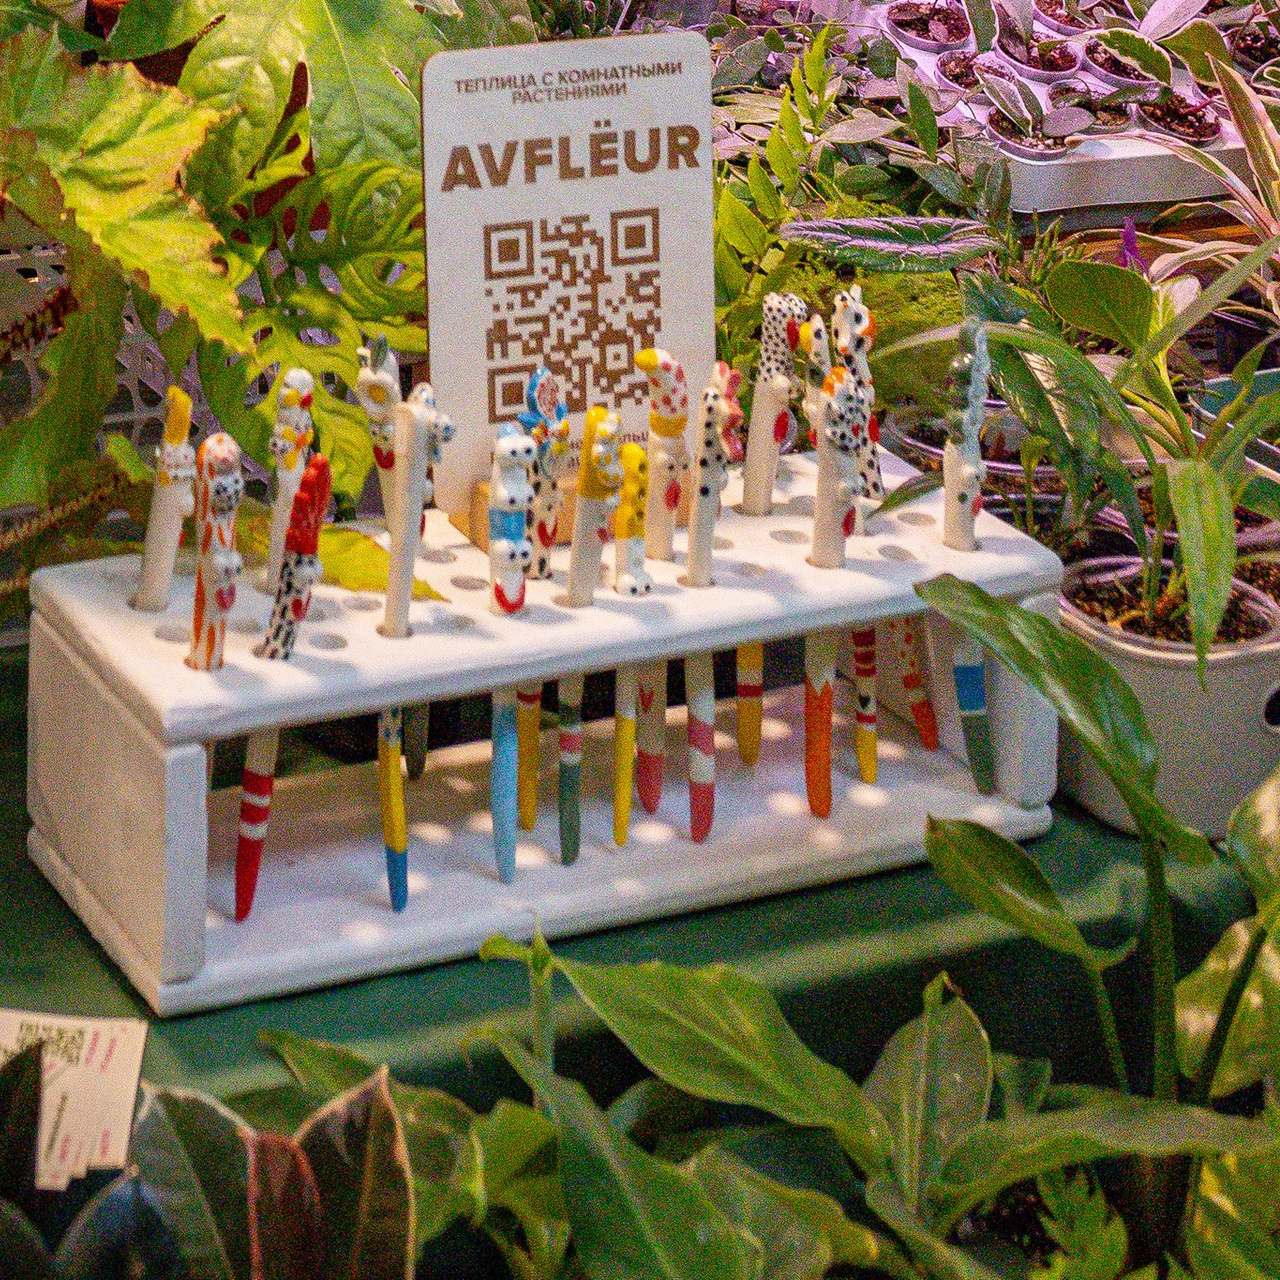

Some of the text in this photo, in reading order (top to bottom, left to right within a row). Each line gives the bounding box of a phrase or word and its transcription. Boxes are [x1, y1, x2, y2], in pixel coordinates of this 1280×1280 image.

[454, 61, 683, 94] ТЕПЛИЦА С КОМНАТНЫМИ
[512, 82, 628, 105] РАСТЕНИЯМИ
[440, 119, 701, 192] AVFLËUR
